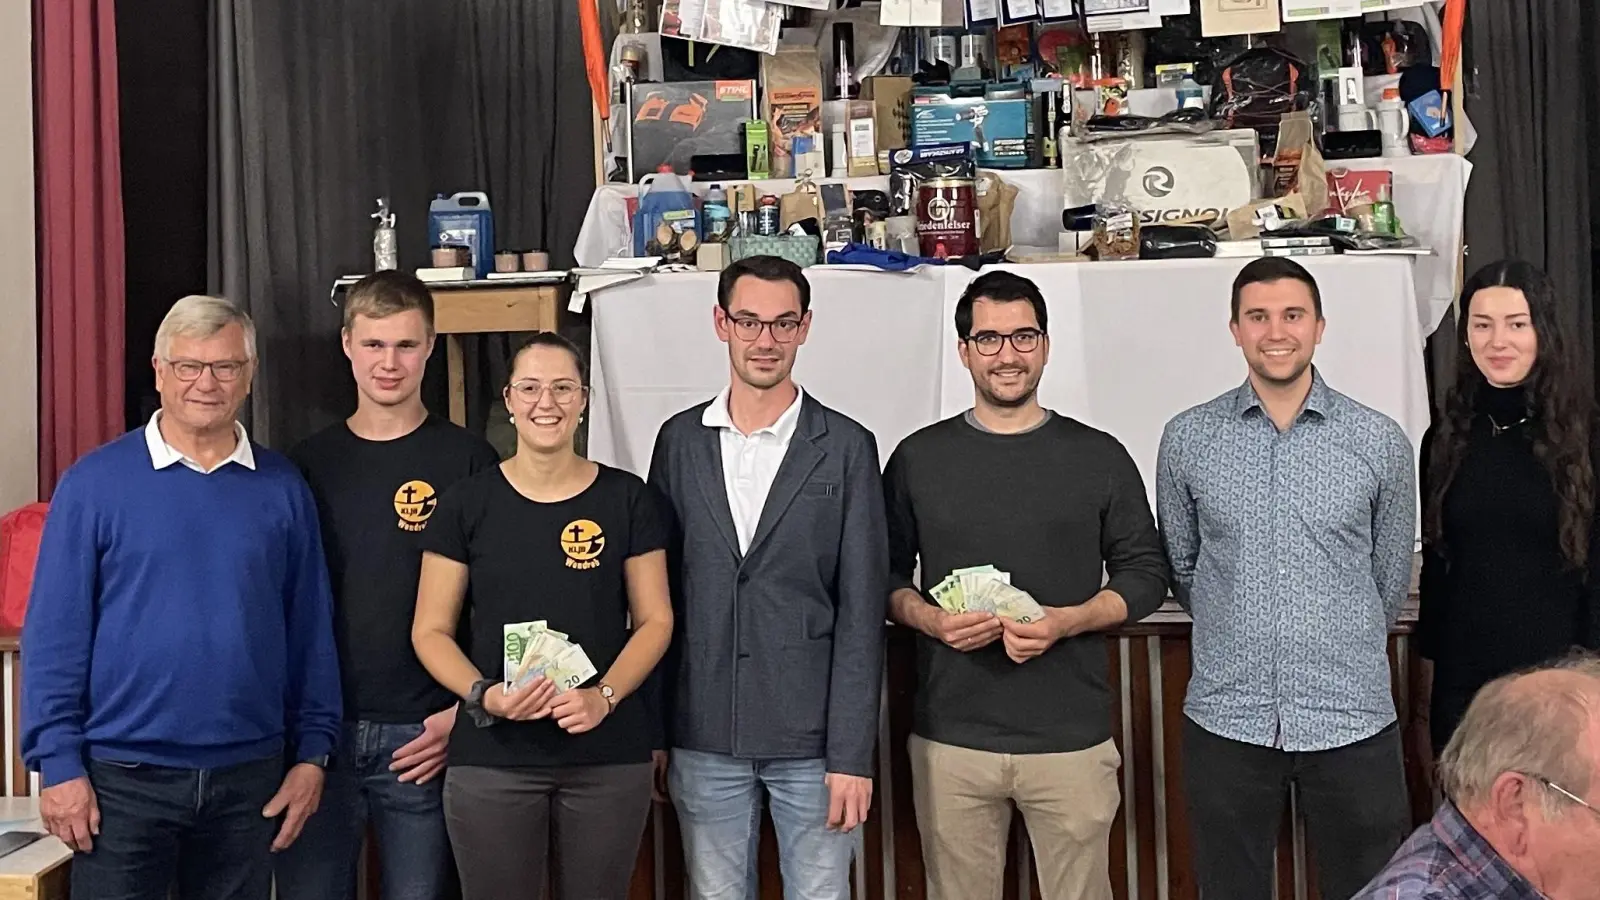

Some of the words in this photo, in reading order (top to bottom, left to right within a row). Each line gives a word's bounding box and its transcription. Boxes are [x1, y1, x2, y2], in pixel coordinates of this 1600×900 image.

[720, 85, 749, 94] STIHL
[506, 632, 520, 658] 100
[564, 674, 580, 688] 20
